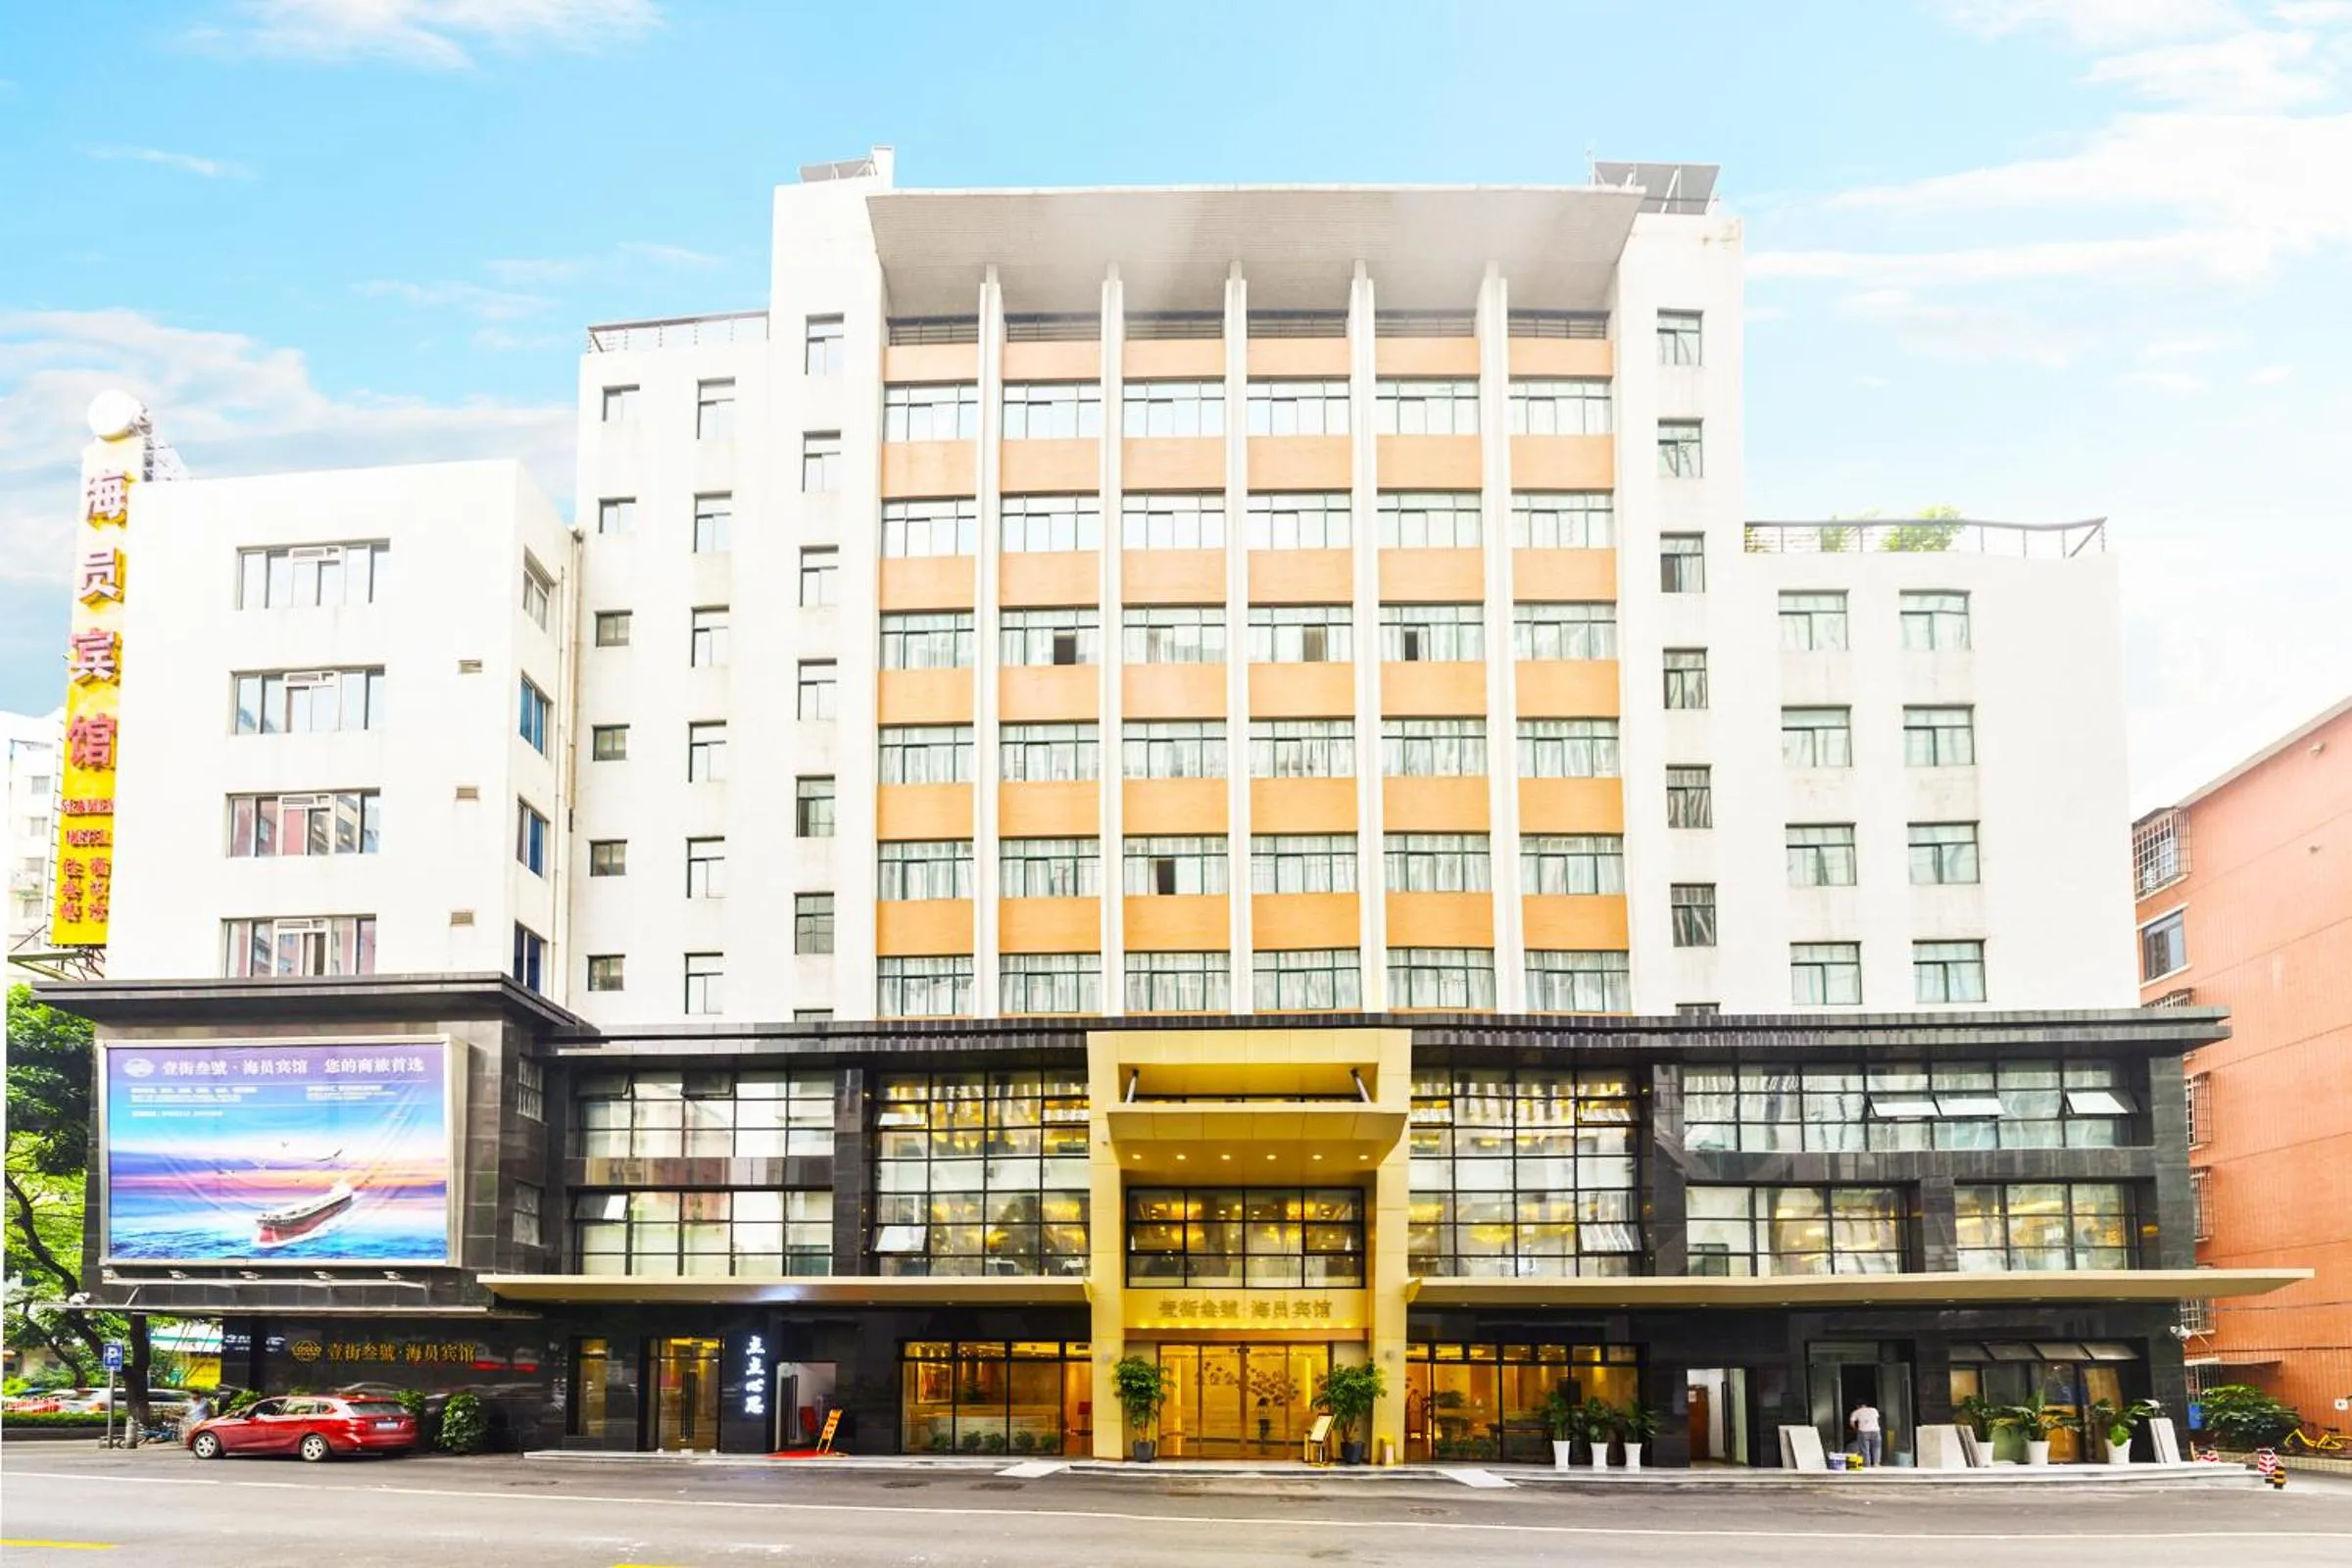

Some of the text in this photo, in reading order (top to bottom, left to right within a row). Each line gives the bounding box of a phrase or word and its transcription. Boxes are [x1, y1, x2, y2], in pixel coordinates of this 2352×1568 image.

[70, 470, 126, 770] 海员宾馆
[324, 1056, 424, 1073] 您的商旅首选
[108, 1347, 119, 1364] P
